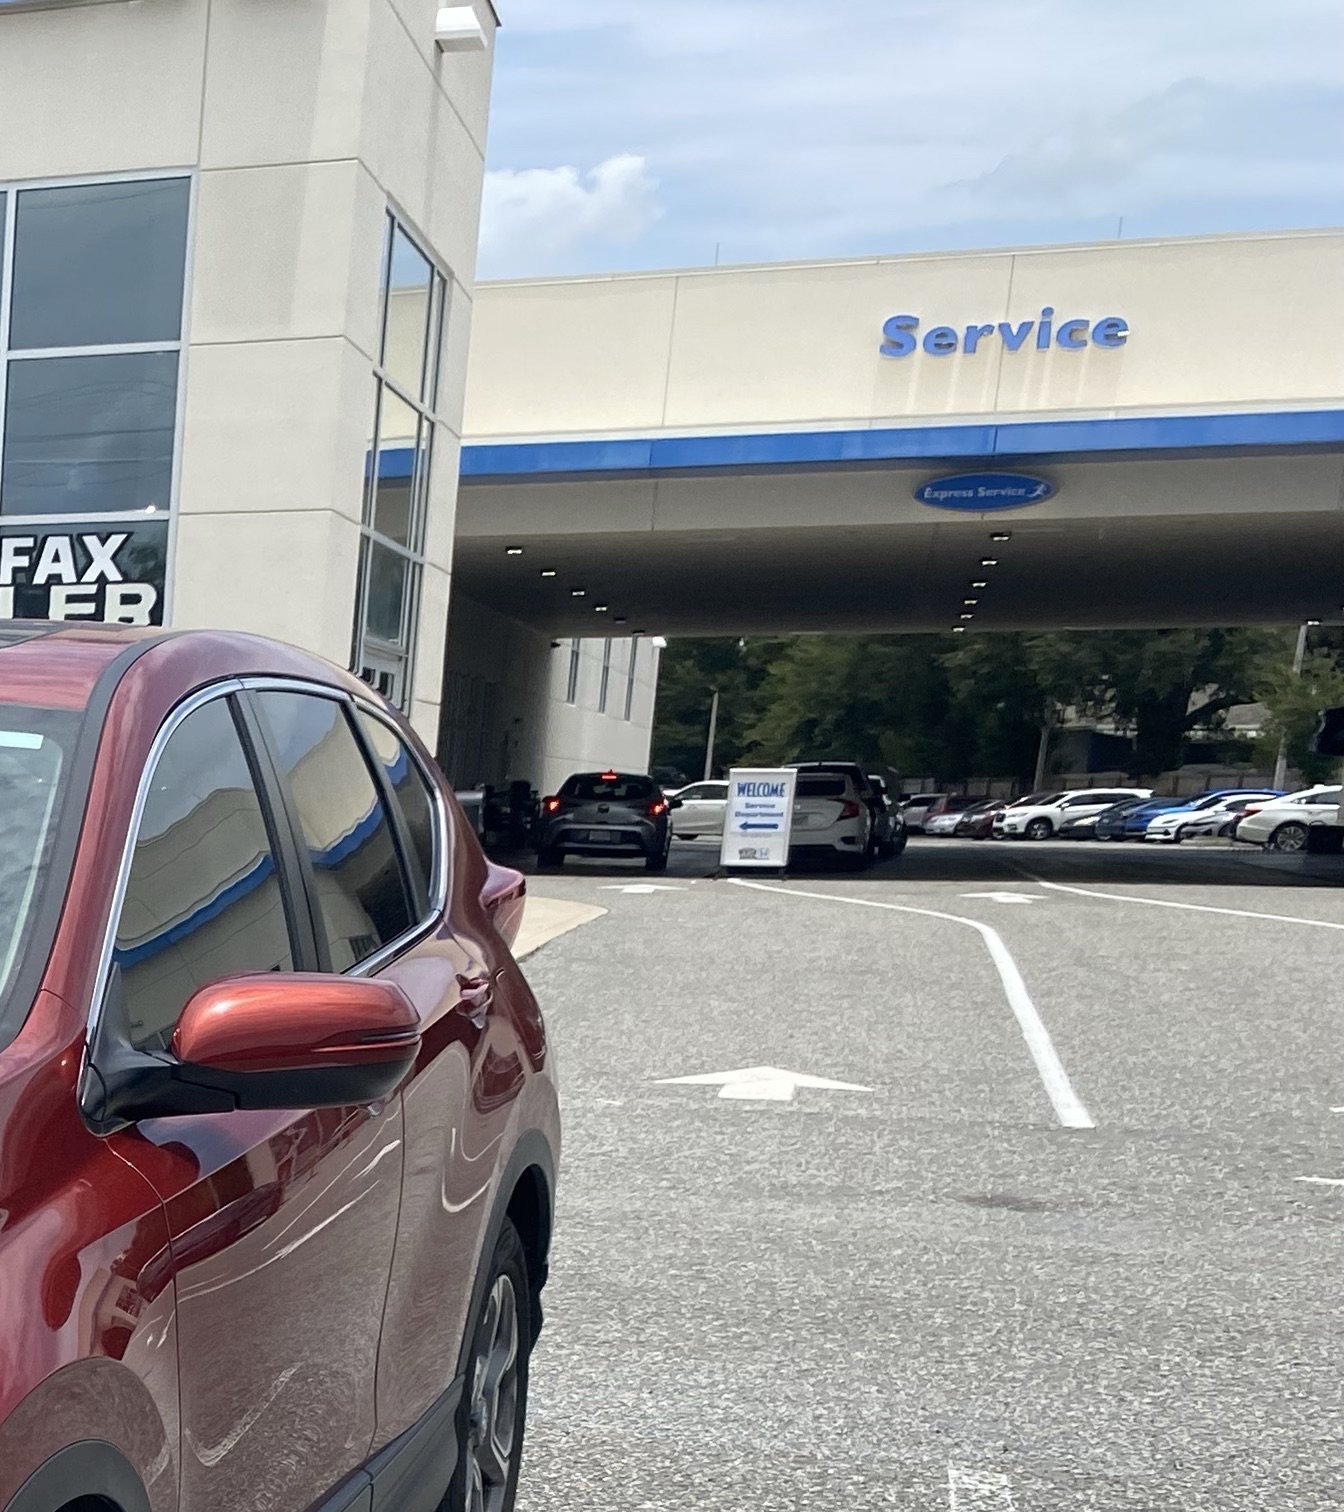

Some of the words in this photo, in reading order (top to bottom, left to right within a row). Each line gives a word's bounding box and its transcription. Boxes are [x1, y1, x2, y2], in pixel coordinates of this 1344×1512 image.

[879, 306, 1131, 357] Service
[923, 487, 973, 501] Express
[977, 486, 1026, 498] Service
[737, 782, 786, 798] WELCOME
